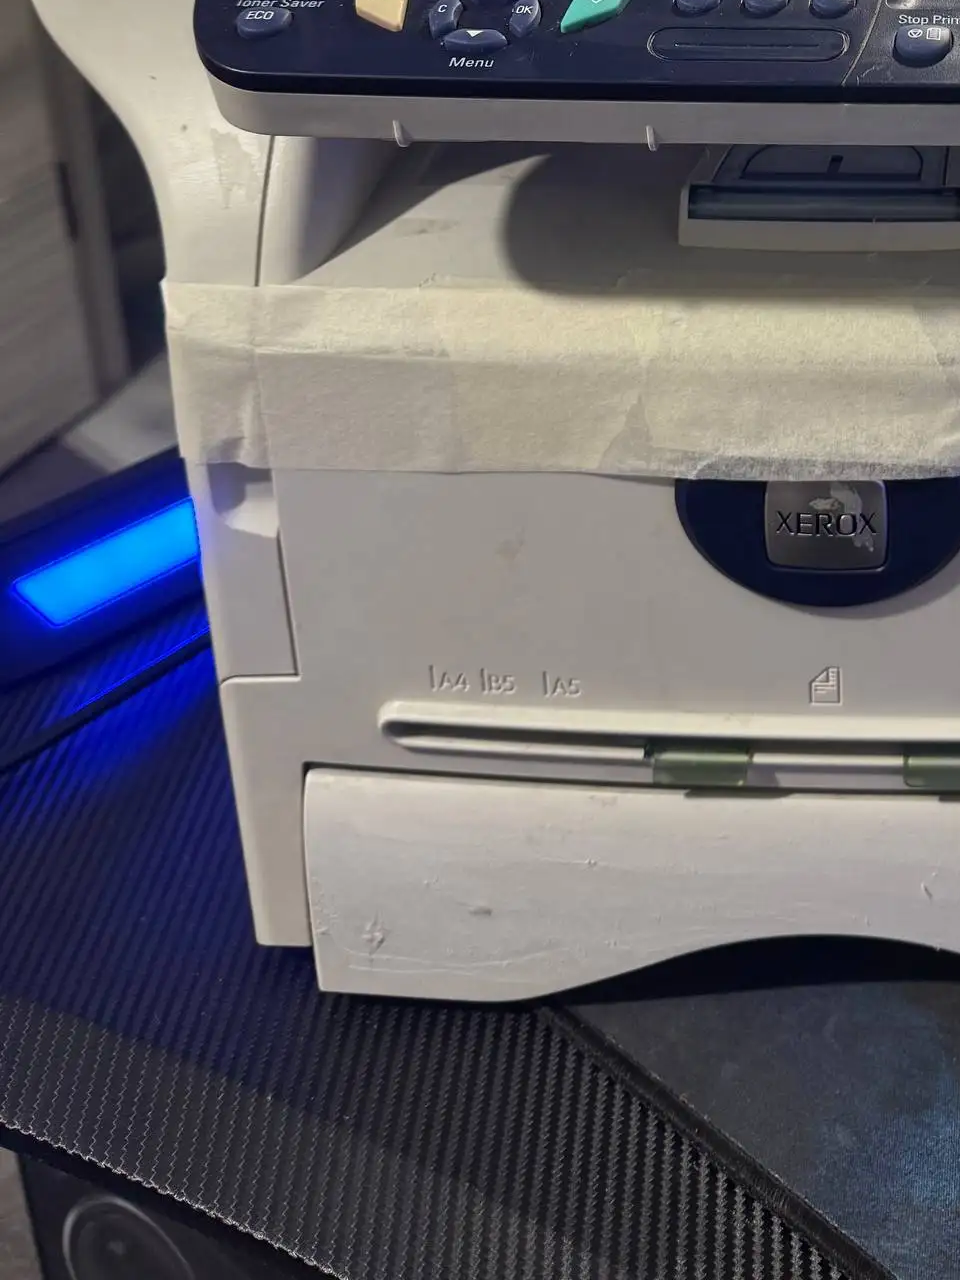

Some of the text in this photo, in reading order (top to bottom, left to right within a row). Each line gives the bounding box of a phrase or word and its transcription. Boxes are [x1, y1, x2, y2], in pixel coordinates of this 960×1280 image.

[437, 4, 448, 13] C
[516, 5, 533, 14] OK
[246, 10, 274, 20] ECO
[898, 14, 929, 26] Stop
[449, 57, 494, 68] Menu
[776, 510, 878, 536] XEROX
[439, 671, 470, 692] A4
